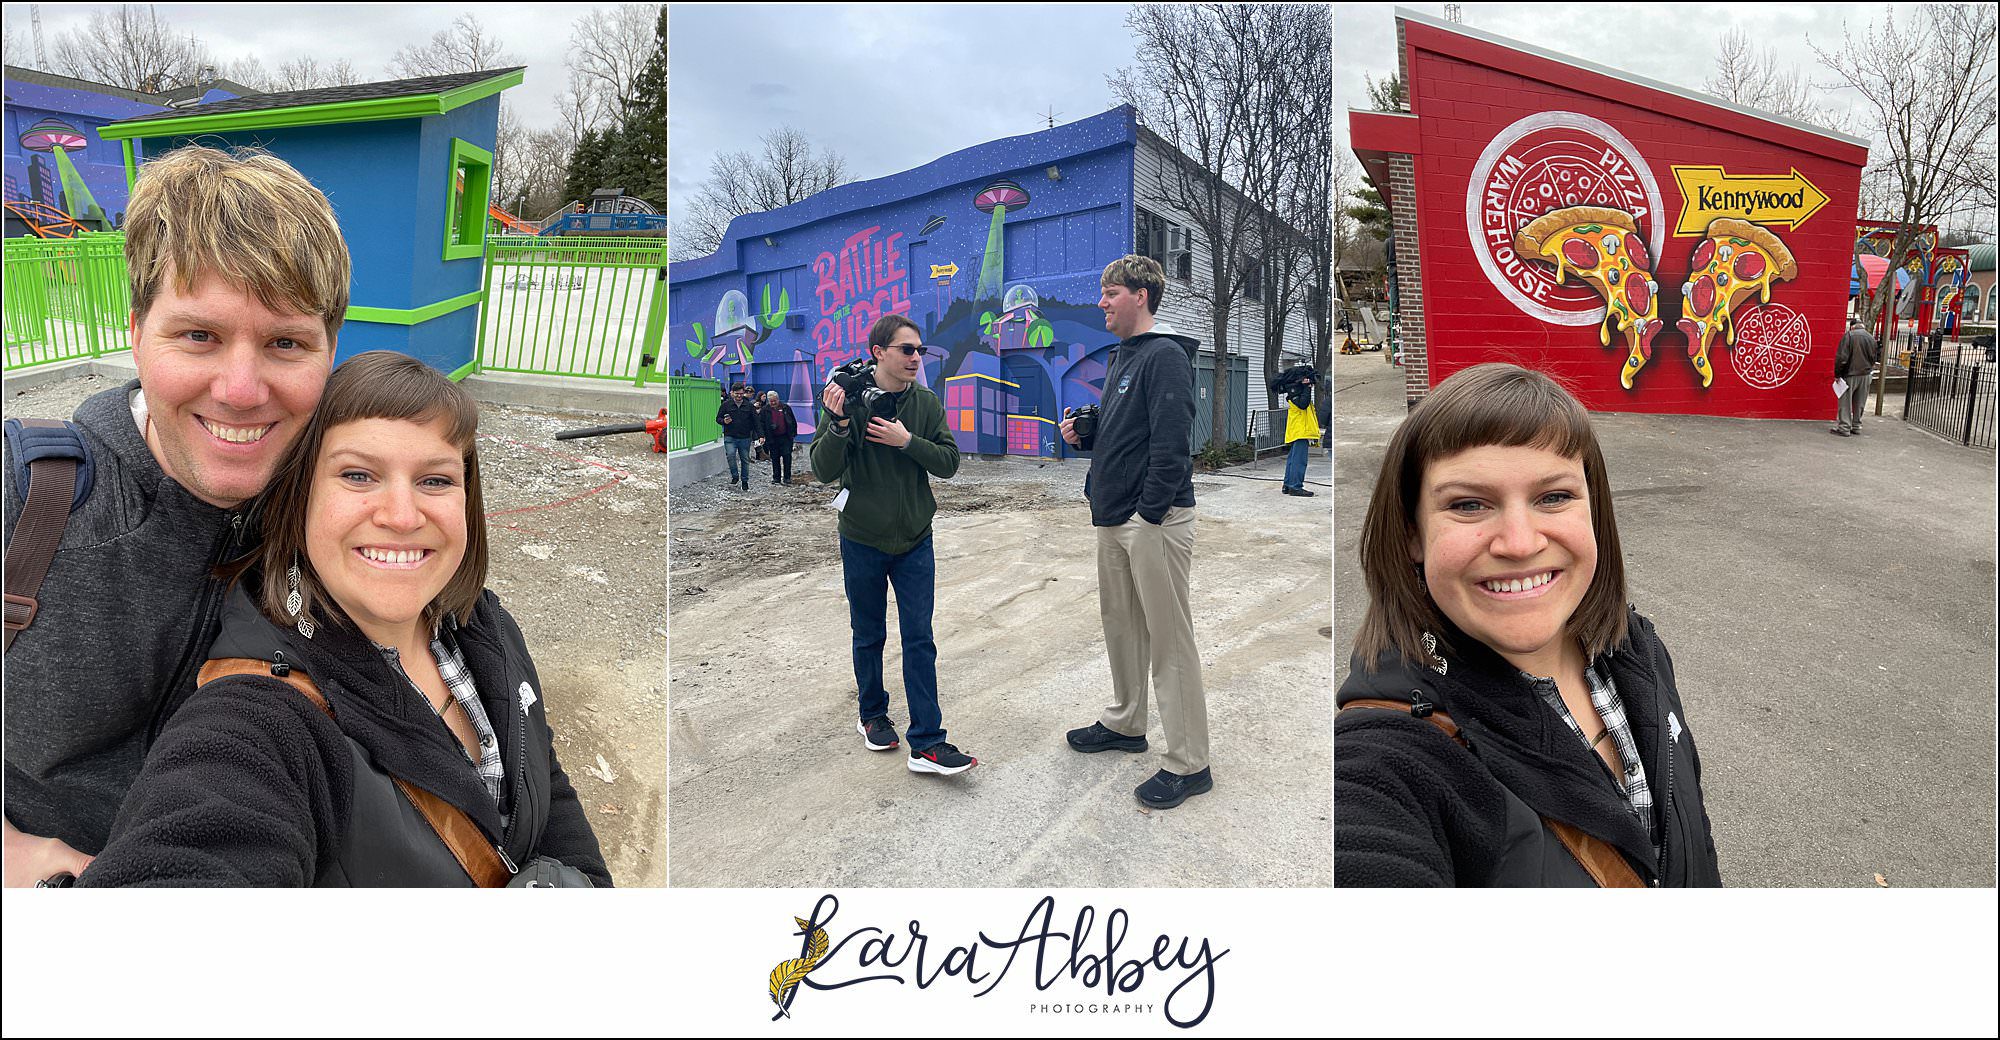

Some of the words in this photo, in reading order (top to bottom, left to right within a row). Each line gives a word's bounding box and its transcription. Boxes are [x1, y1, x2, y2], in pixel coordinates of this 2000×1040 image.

[1599, 148, 1648, 219] PIZZA
[1698, 185, 1805, 215] Kennywood
[1486, 154, 1553, 303] WAREHOUSE
[813, 225, 906, 316] BATTLE
